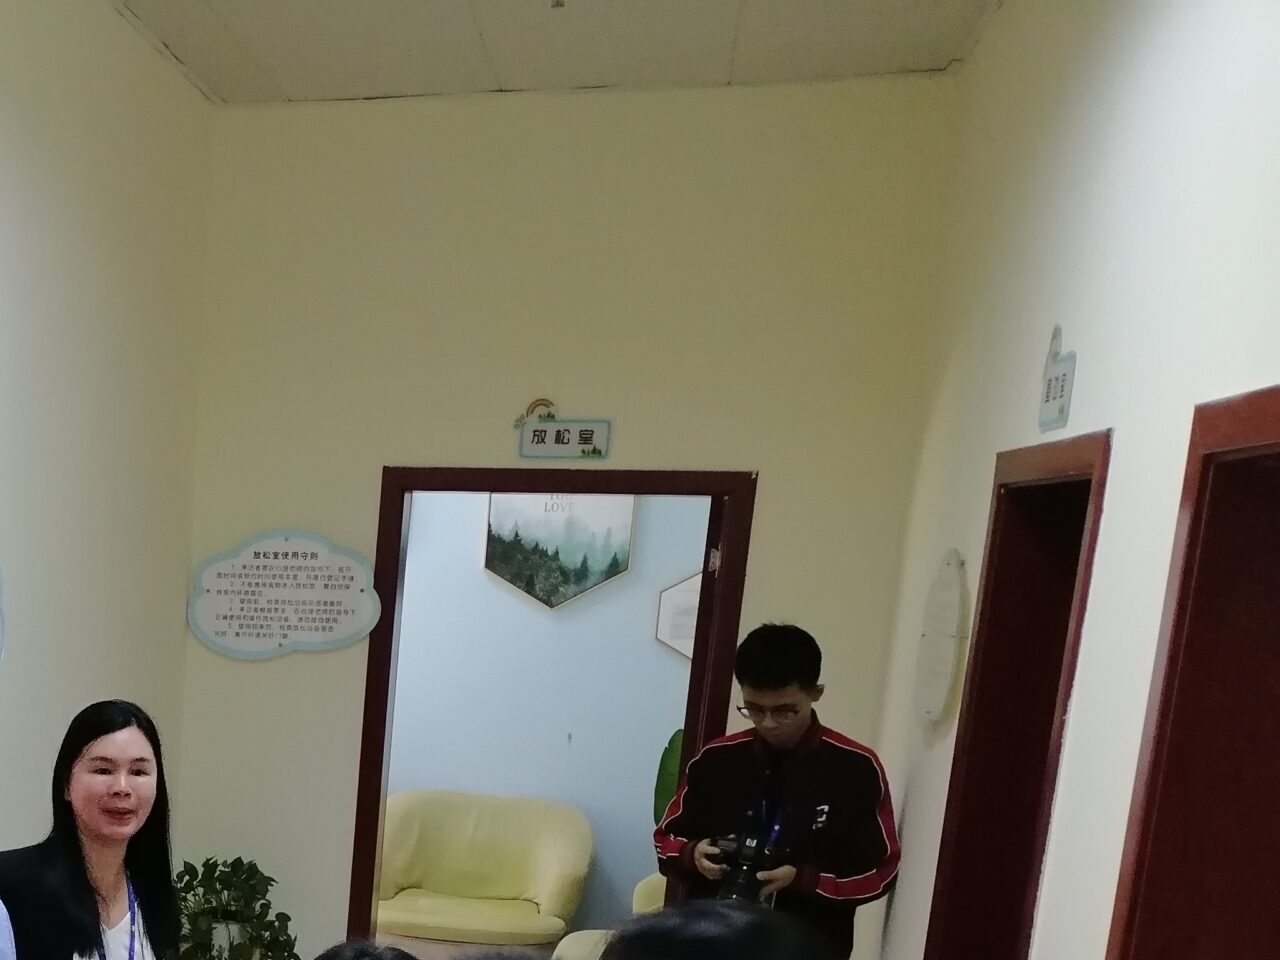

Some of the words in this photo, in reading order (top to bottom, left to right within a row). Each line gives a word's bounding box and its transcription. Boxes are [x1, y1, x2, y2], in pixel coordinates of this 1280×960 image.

[531, 428, 595, 445] 放松室
[544, 501, 574, 513] LOVE
[253, 551, 319, 561] 放松室使用守则
